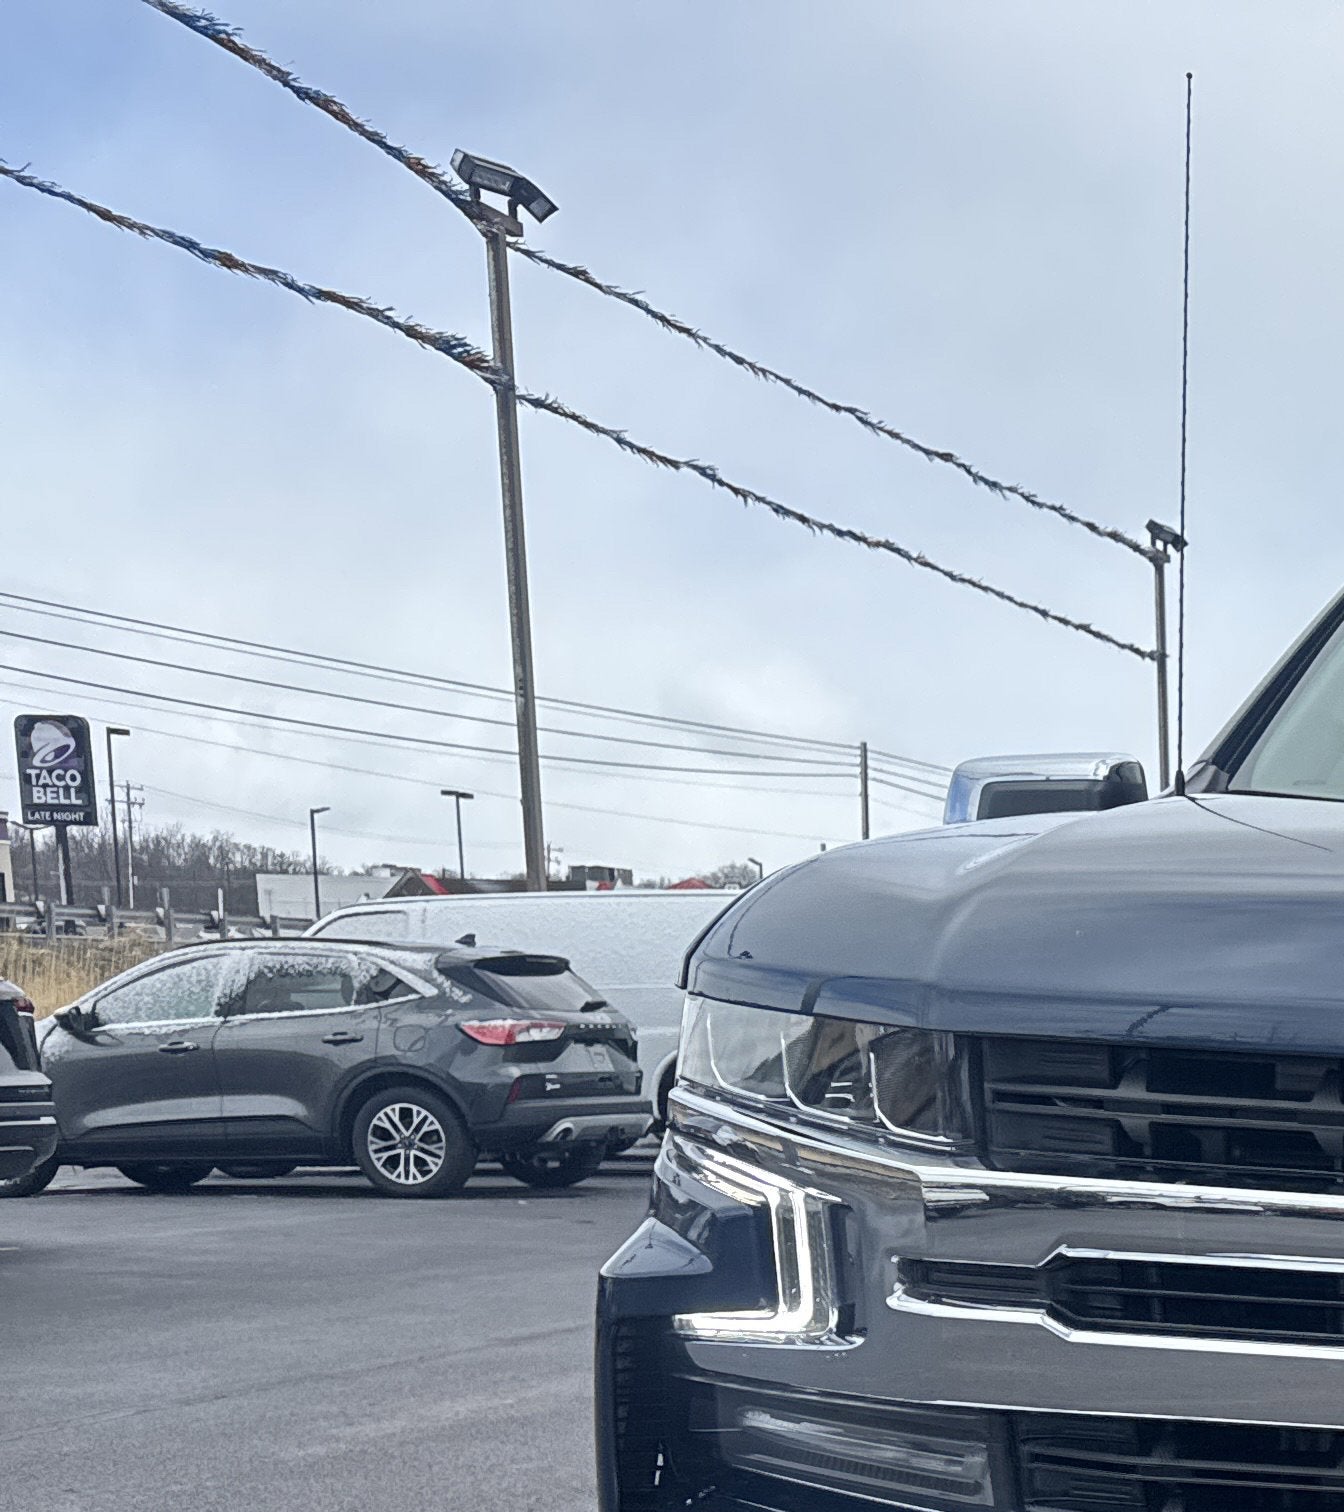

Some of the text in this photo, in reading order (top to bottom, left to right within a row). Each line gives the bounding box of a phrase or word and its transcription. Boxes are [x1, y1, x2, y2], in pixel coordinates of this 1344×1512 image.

[26, 768, 82, 787] TACO
[32, 787, 83, 805] BELL
[27, 811, 85, 822] LATE NIGHT
